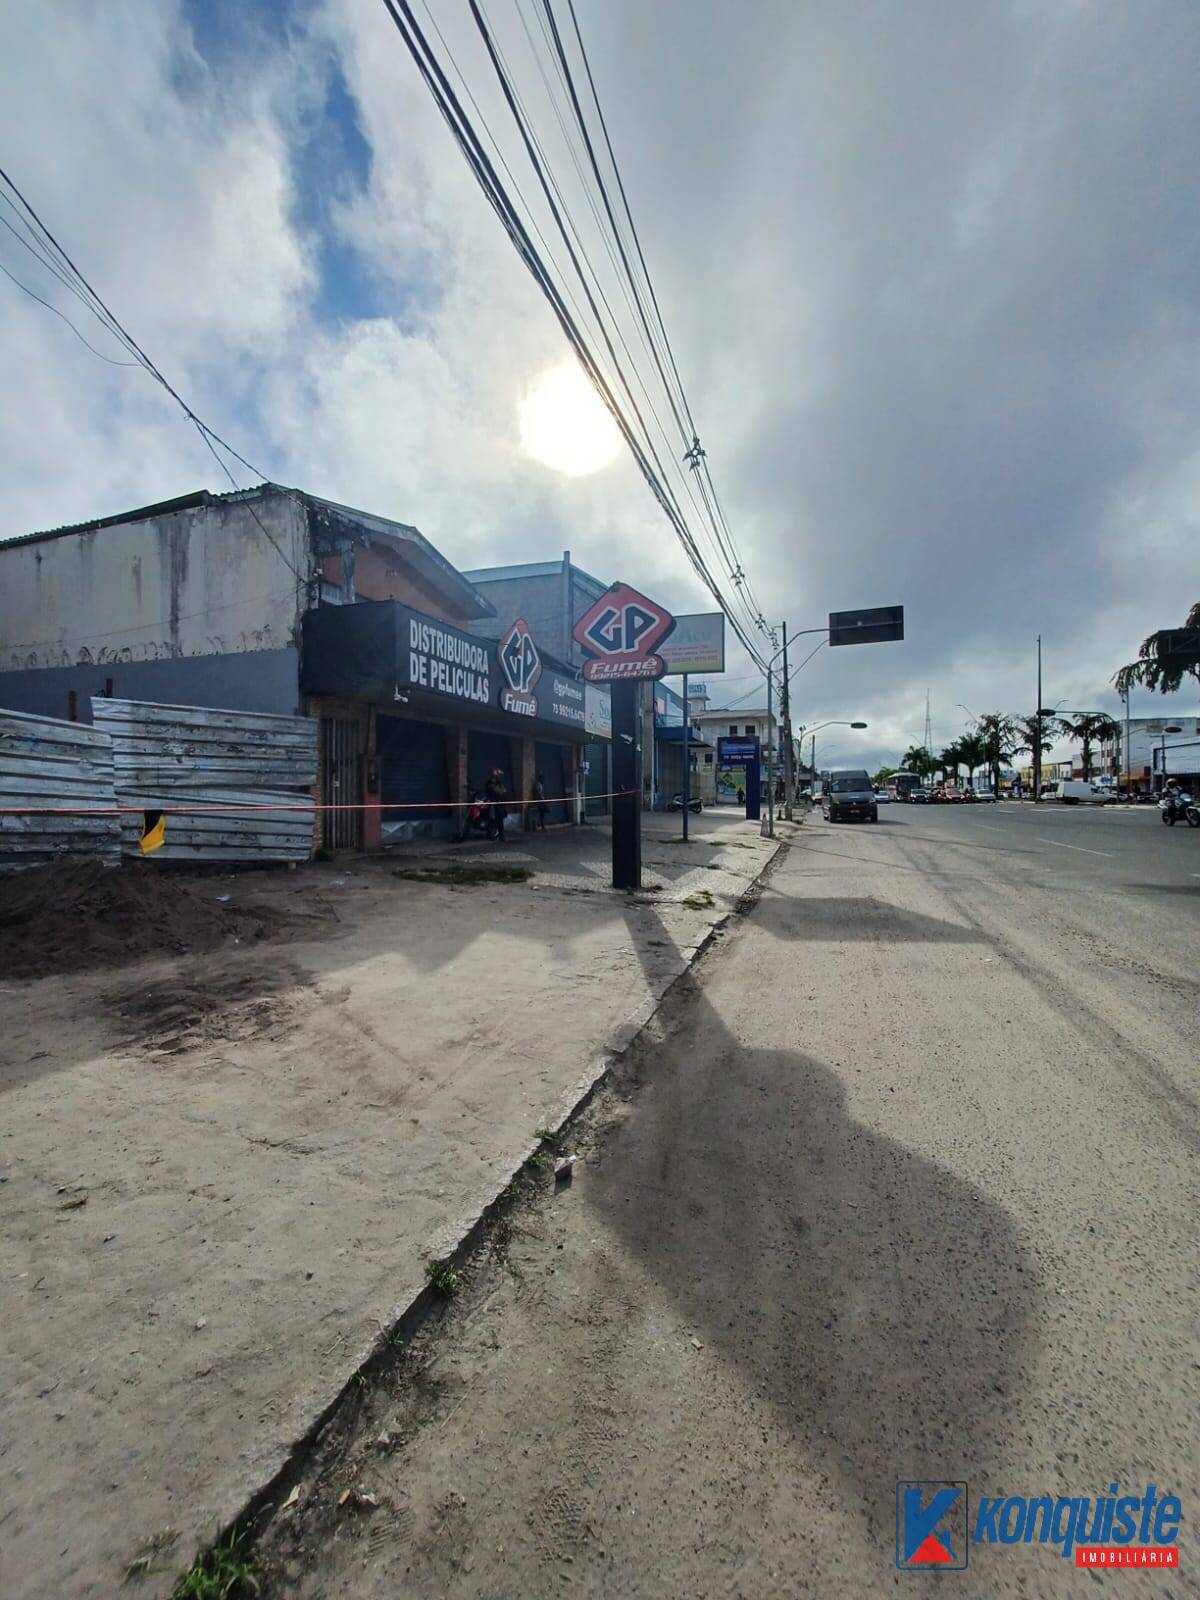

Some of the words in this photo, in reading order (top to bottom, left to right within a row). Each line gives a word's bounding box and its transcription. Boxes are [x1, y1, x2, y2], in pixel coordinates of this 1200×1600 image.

[409, 619, 489, 673] DISTRIBUIDORA
[409, 651, 428, 685] DE
[429, 661, 490, 704] PELICULAS
[591, 658, 658, 674] Fumê
[504, 692, 537, 717] Fumê
